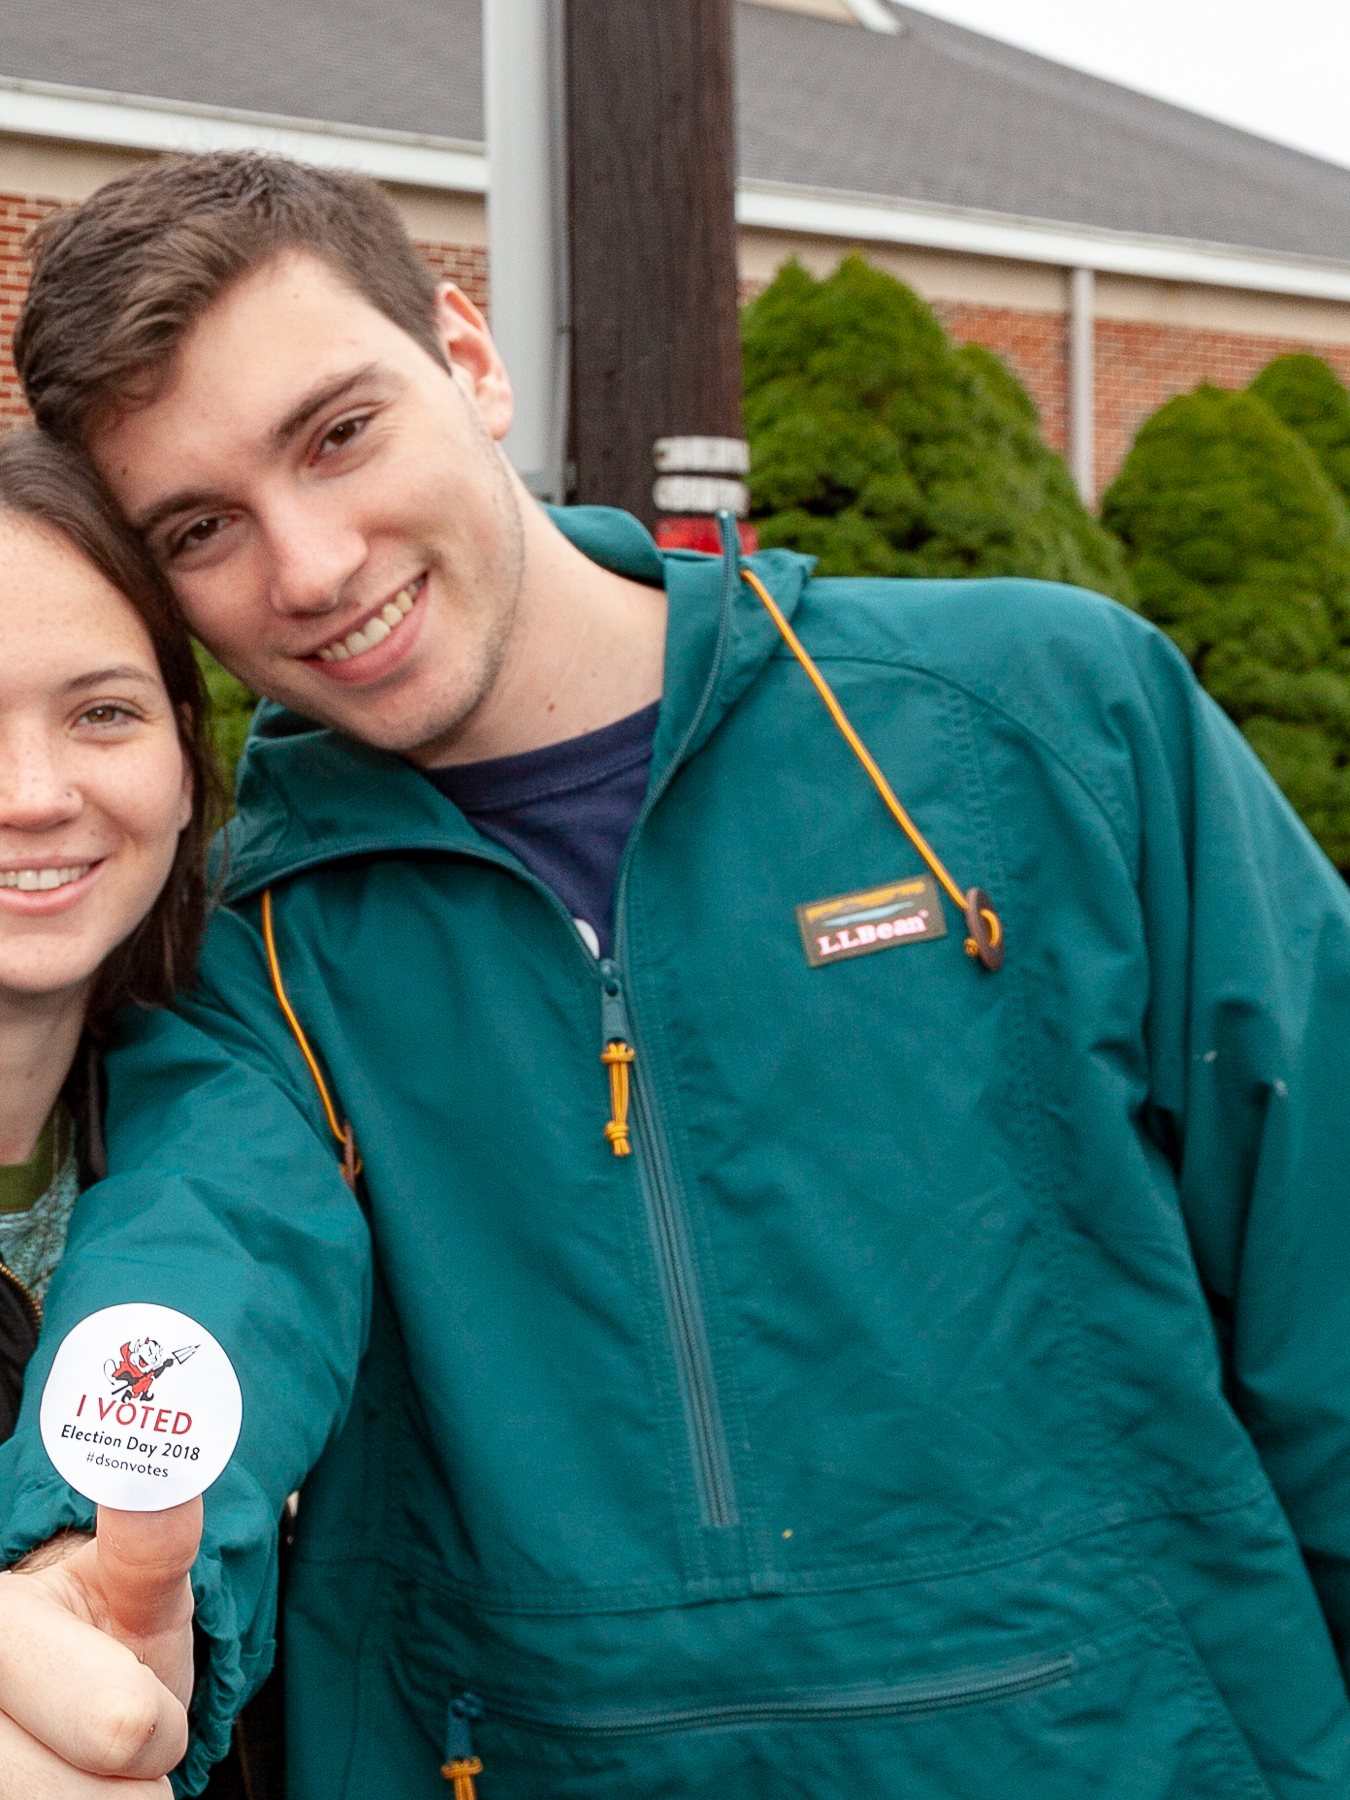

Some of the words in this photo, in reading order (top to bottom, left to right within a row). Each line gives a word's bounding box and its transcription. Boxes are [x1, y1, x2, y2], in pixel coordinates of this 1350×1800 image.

[76, 1394, 87, 1417] I
[98, 1396, 193, 1435] VOTED
[60, 1424, 122, 1448] Election
[126, 1436, 158, 1459] Day
[161, 1442, 201, 1462] 2018
[86, 1451, 169, 1478] #dsonvotes
